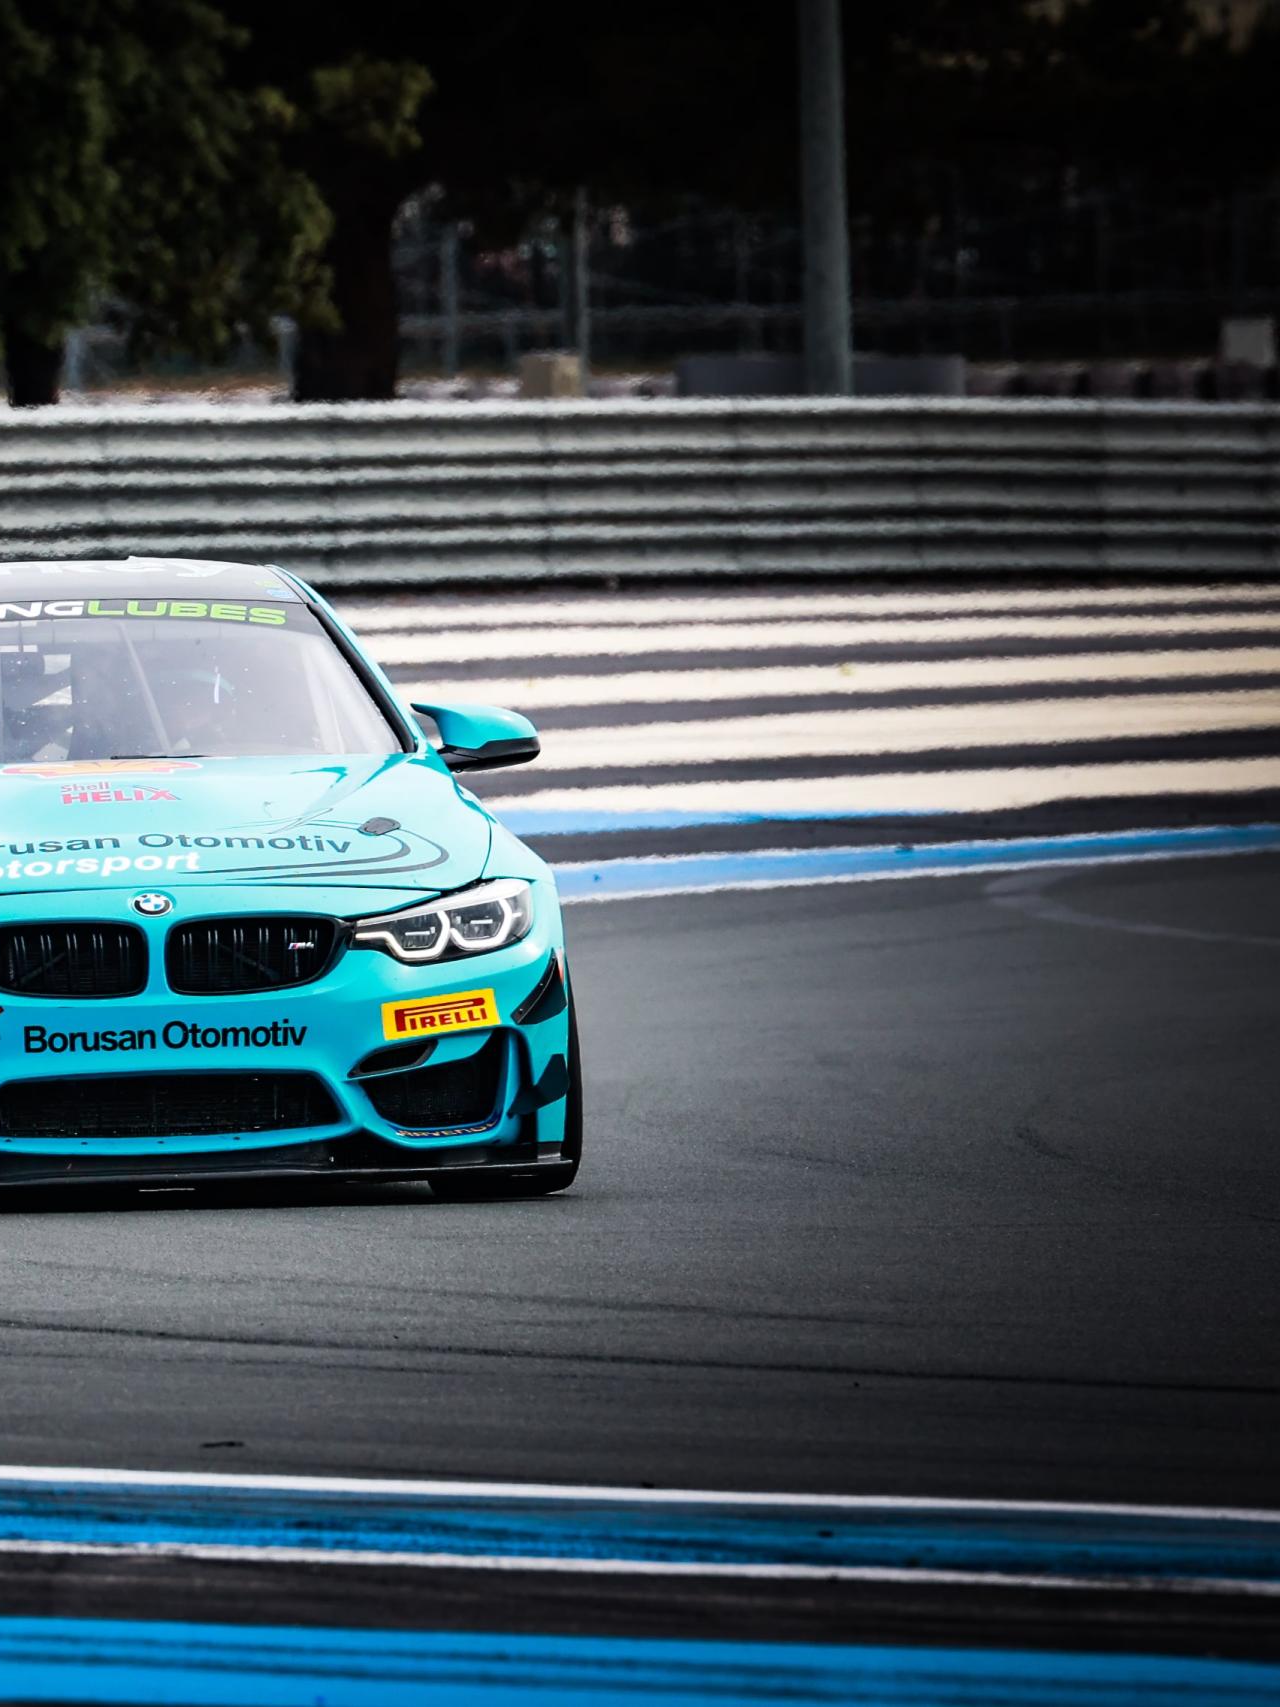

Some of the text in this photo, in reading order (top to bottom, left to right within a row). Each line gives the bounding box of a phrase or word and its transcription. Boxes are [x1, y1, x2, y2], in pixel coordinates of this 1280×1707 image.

[60, 782, 110, 792] Shell
[61, 788, 178, 804] HELIX
[138, 833, 351, 854] Otomotiv
[394, 997, 488, 1032] PIRELLI
[23, 1018, 308, 1053] Borusan Otomotiv
